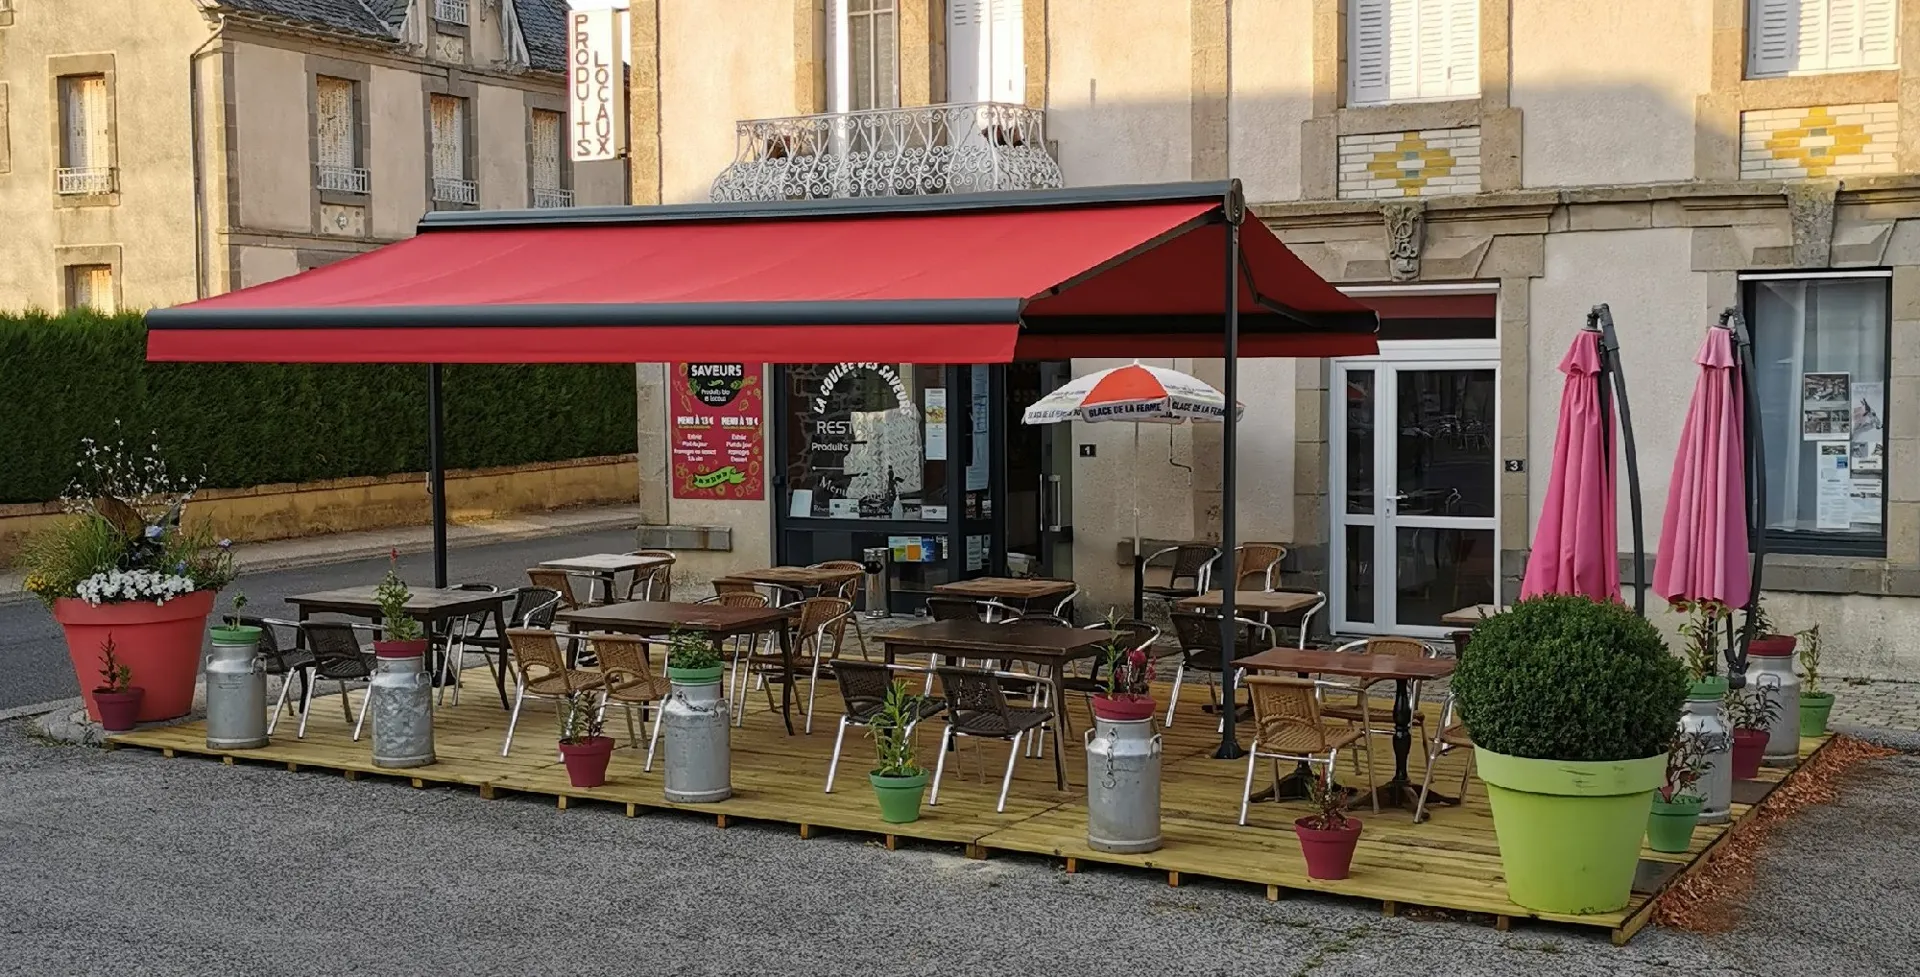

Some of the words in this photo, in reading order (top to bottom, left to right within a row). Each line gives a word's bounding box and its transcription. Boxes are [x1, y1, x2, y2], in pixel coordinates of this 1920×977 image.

[593, 50, 611, 156] LOCAUX
[691, 364, 742, 377] SAVEURS
[813, 397, 828, 414] LA
[878, 365, 913, 416] SAVEURS
[1088, 406, 1112, 418] GLACE
[1113, 405, 1124, 414] DE
[1124, 404, 1135, 413] LA
[1136, 402, 1162, 412] FERME
[1171, 401, 1192, 411] GLACE
[811, 442, 849, 451] Produits
[1085, 446, 1090, 456] 1
[1510, 460, 1519, 471] 3
